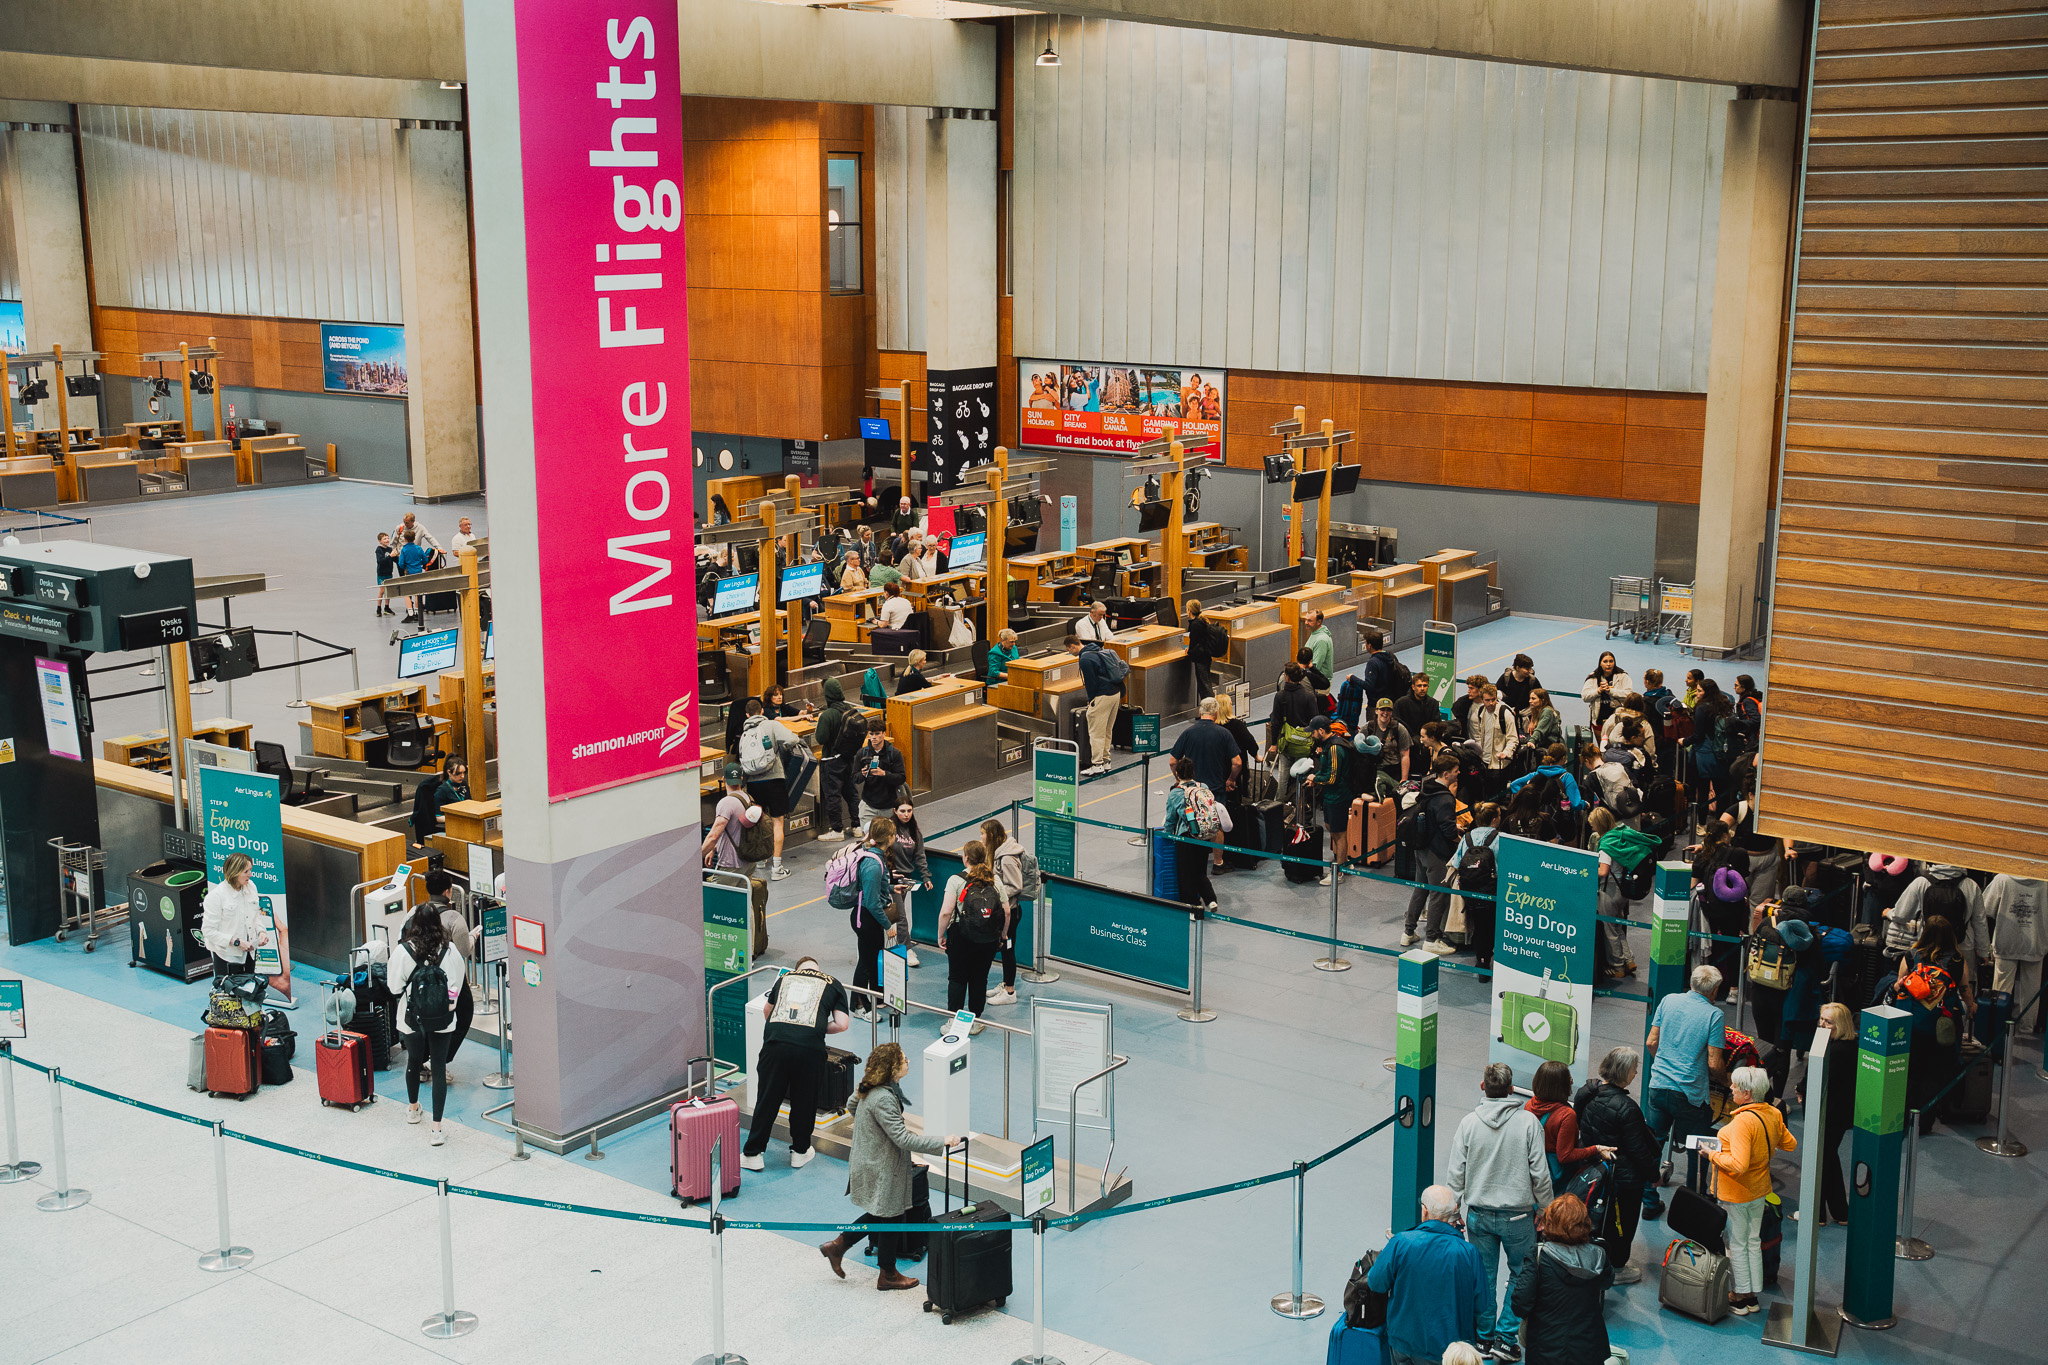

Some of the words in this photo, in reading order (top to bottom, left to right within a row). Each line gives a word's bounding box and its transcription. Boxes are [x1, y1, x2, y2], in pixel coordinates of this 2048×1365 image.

[589, 16, 682, 348] Flights
[952, 384, 973, 392] BAGGAGE
[1027, 410, 1042, 419] SUN
[1064, 413, 1080, 422] CITY
[1027, 418, 1055, 426] HOLIDAYS
[1064, 421, 1087, 429] BREAKS
[1104, 416, 1120, 424] USA
[1120, 416, 1126, 425] &
[1144, 426, 1162, 434] HOLID
[1182, 422, 1219, 432] HOLIDAYS
[1056, 434, 1072, 444] find
[1074, 436, 1090, 445] and
[1092, 436, 1114, 447] book
[1116, 439, 1124, 448] at
[608, 381, 674, 616] More
[948, 498, 954, 506] 5
[712, 534, 717, 543] 3
[40, 578, 54, 588] Desks
[40, 588, 54, 598] 1-10
[802, 586, 814, 594] Drop
[726, 591, 746, 600] Check-in
[4, 610, 20, 620] Check
[26, 614, 30, 622] in
[32, 614, 62, 628] Information
[160, 618, 182, 627] Desks
[161, 626, 183, 638] 1-10
[1426, 658, 1448, 669] Carrying
[572, 736, 625, 760] shannon
[626, 726, 666, 746] AIRPORT
[234, 786, 246, 794] Aer
[246, 788, 264, 798] Lingus
[1038, 786, 1052, 794] Does
[194, 776, 204, 828] PASSENGER
[210, 808, 251, 832] Express
[211, 830, 236, 850] Bag
[238, 835, 269, 855] Drop
[212, 851, 226, 861] Use
[252, 858, 275, 869] Lingus
[1554, 864, 1578, 875] Lingus
[264, 872, 279, 882] bag.
[1508, 872, 1522, 880] STEP
[1505, 882, 1556, 912] Express
[721, 916, 738, 924] Lingus
[1505, 906, 1534, 930] Bag
[1538, 914, 1577, 939] Drop
[1111, 921, 1122, 929] Aer
[1122, 924, 1139, 934] Lingus
[704, 929, 721, 940] Does
[722, 932, 727, 940] it
[728, 933, 738, 942] fit?
[1090, 925, 1125, 942] Business
[1126, 934, 1147, 948] Class
[1504, 930, 1524, 942] Drop
[1526, 936, 1546, 946] your
[1546, 940, 1576, 954] tagged
[1502, 942, 1518, 956] bag
[1520, 947, 1542, 960] here.
[1862, 1054, 1881, 1064] Check-in
[1862, 1062, 1870, 1070] Bag
[1870, 1064, 1881, 1072] Drop
[1025, 1171, 1034, 1180] Bag
[1034, 1166, 1046, 1176] Drop
